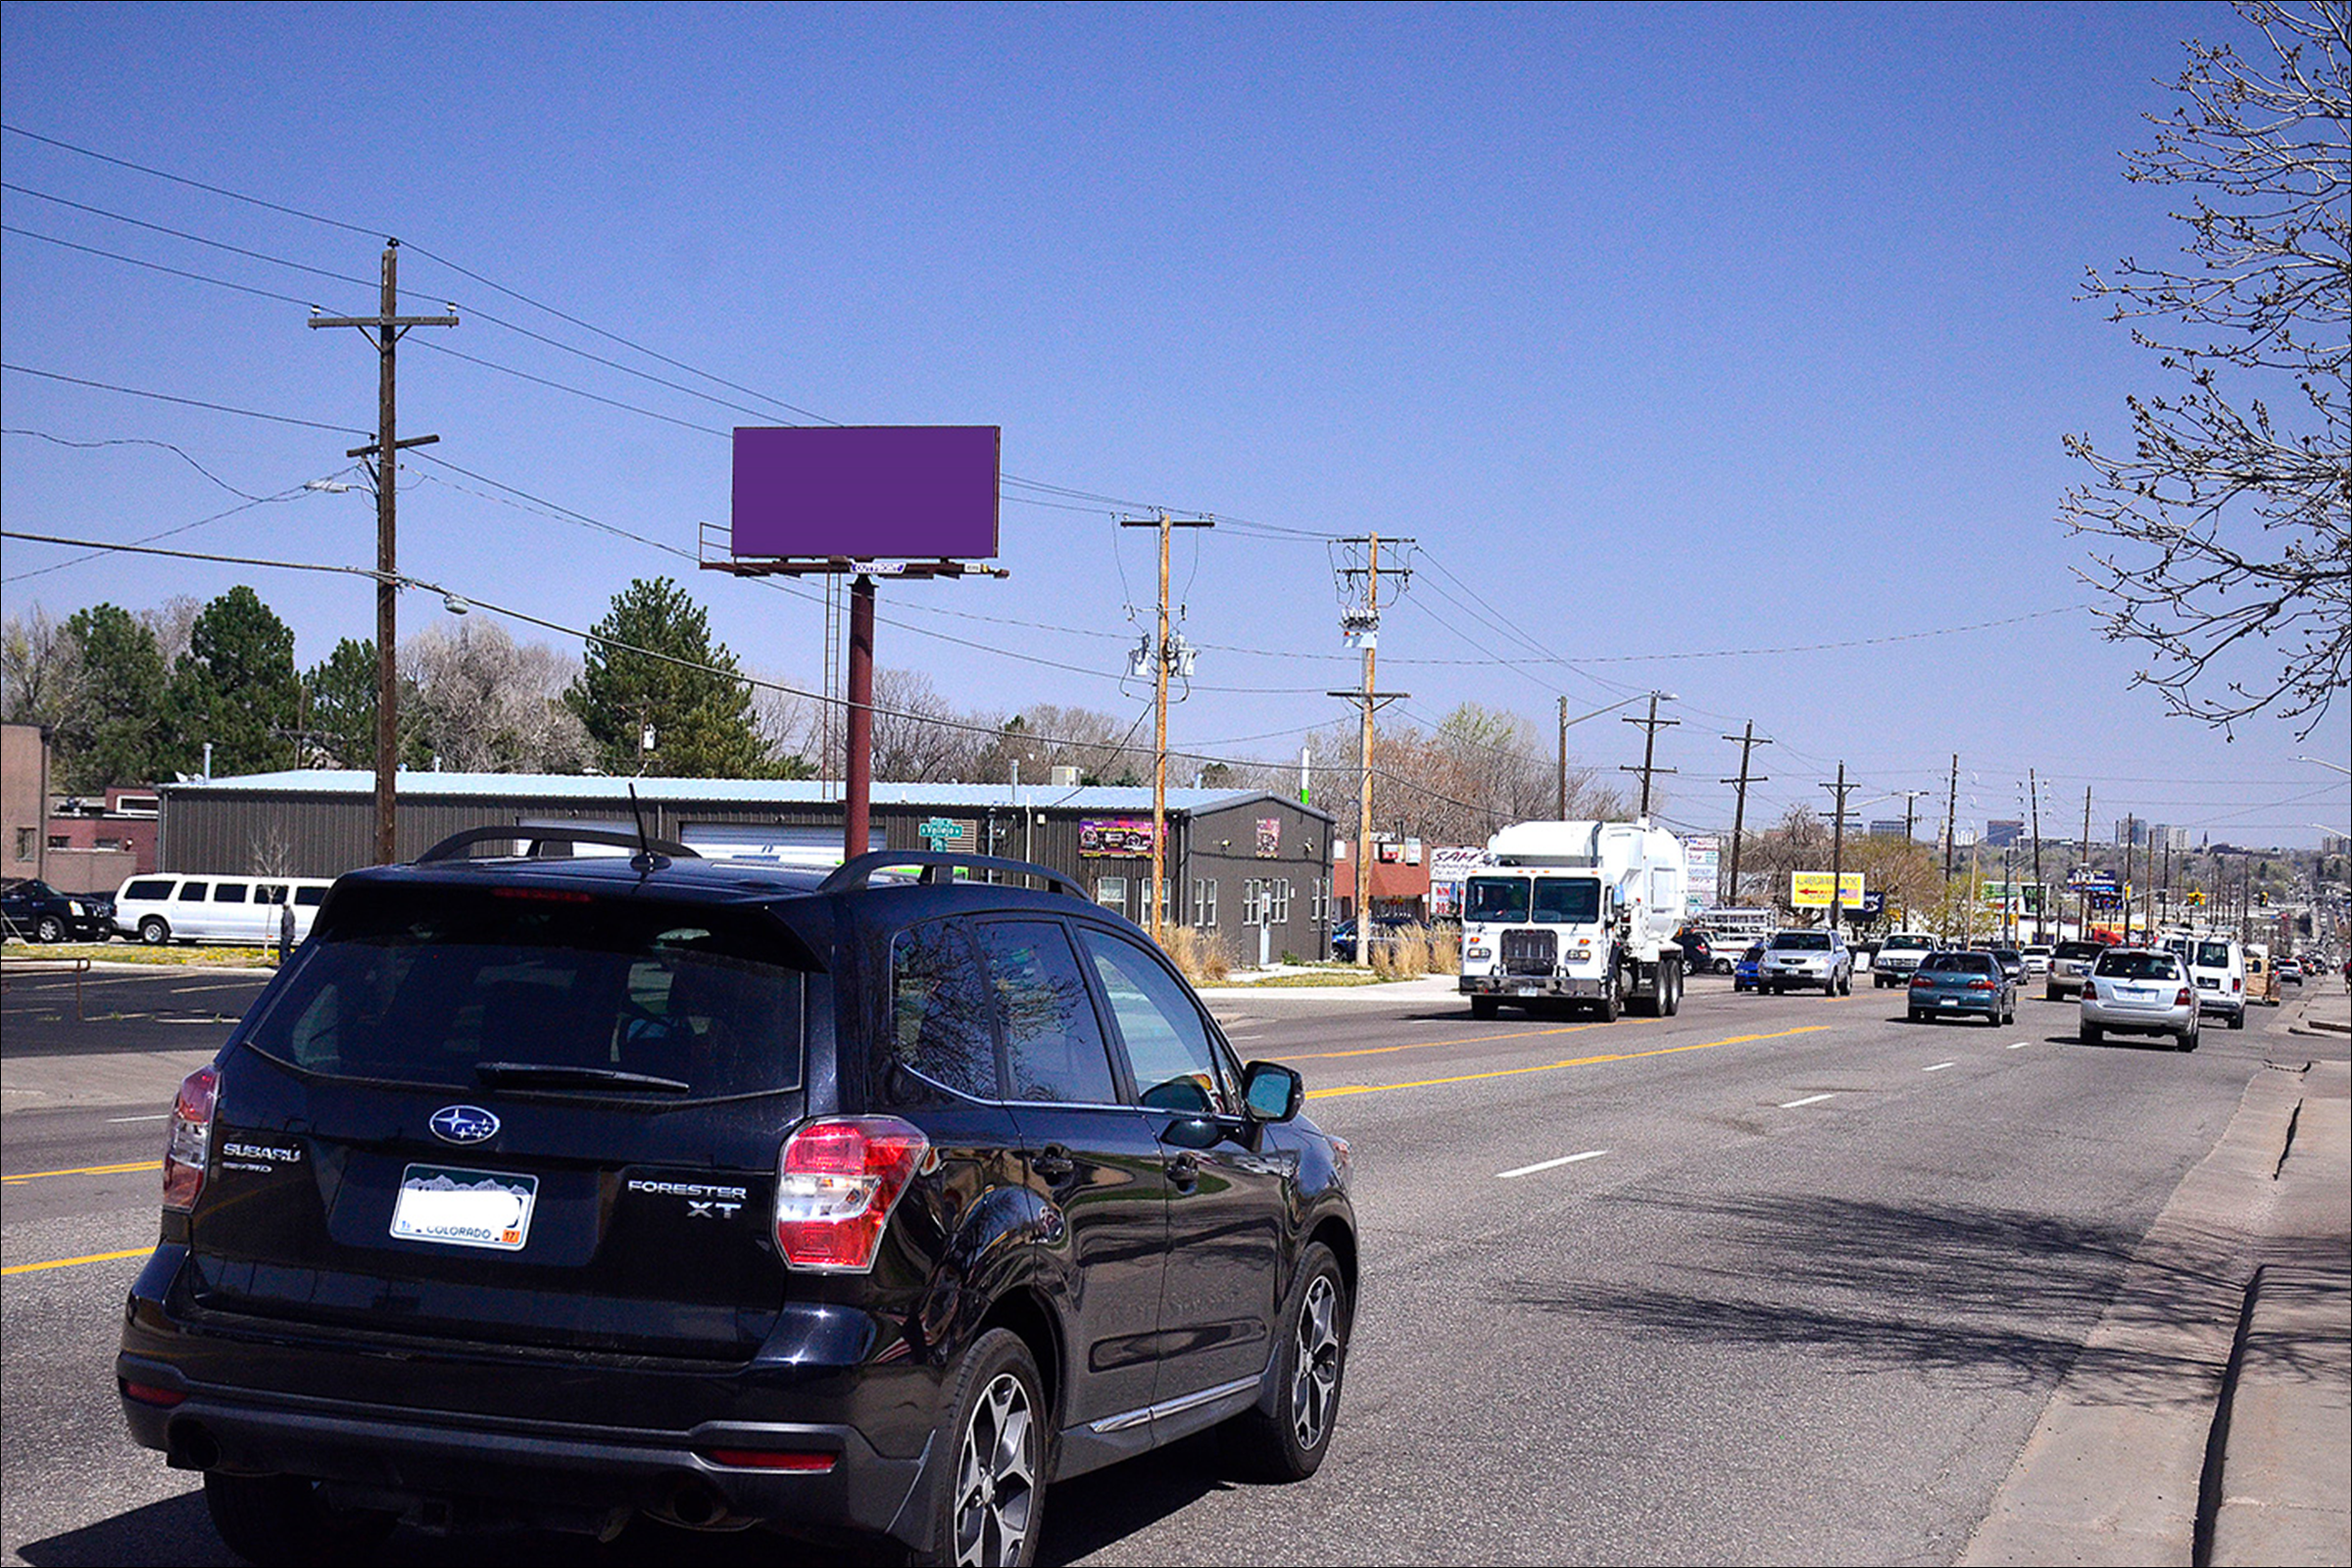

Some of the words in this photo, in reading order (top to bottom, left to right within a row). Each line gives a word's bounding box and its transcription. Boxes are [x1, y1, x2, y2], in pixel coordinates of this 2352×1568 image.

[222, 1143, 301, 1162] SUBARU
[628, 1180, 747, 1200] FORESTER
[686, 1200, 742, 1219] XT
[426, 1225, 492, 1240] COLORADO
[505, 1231, 517, 1242] 17
